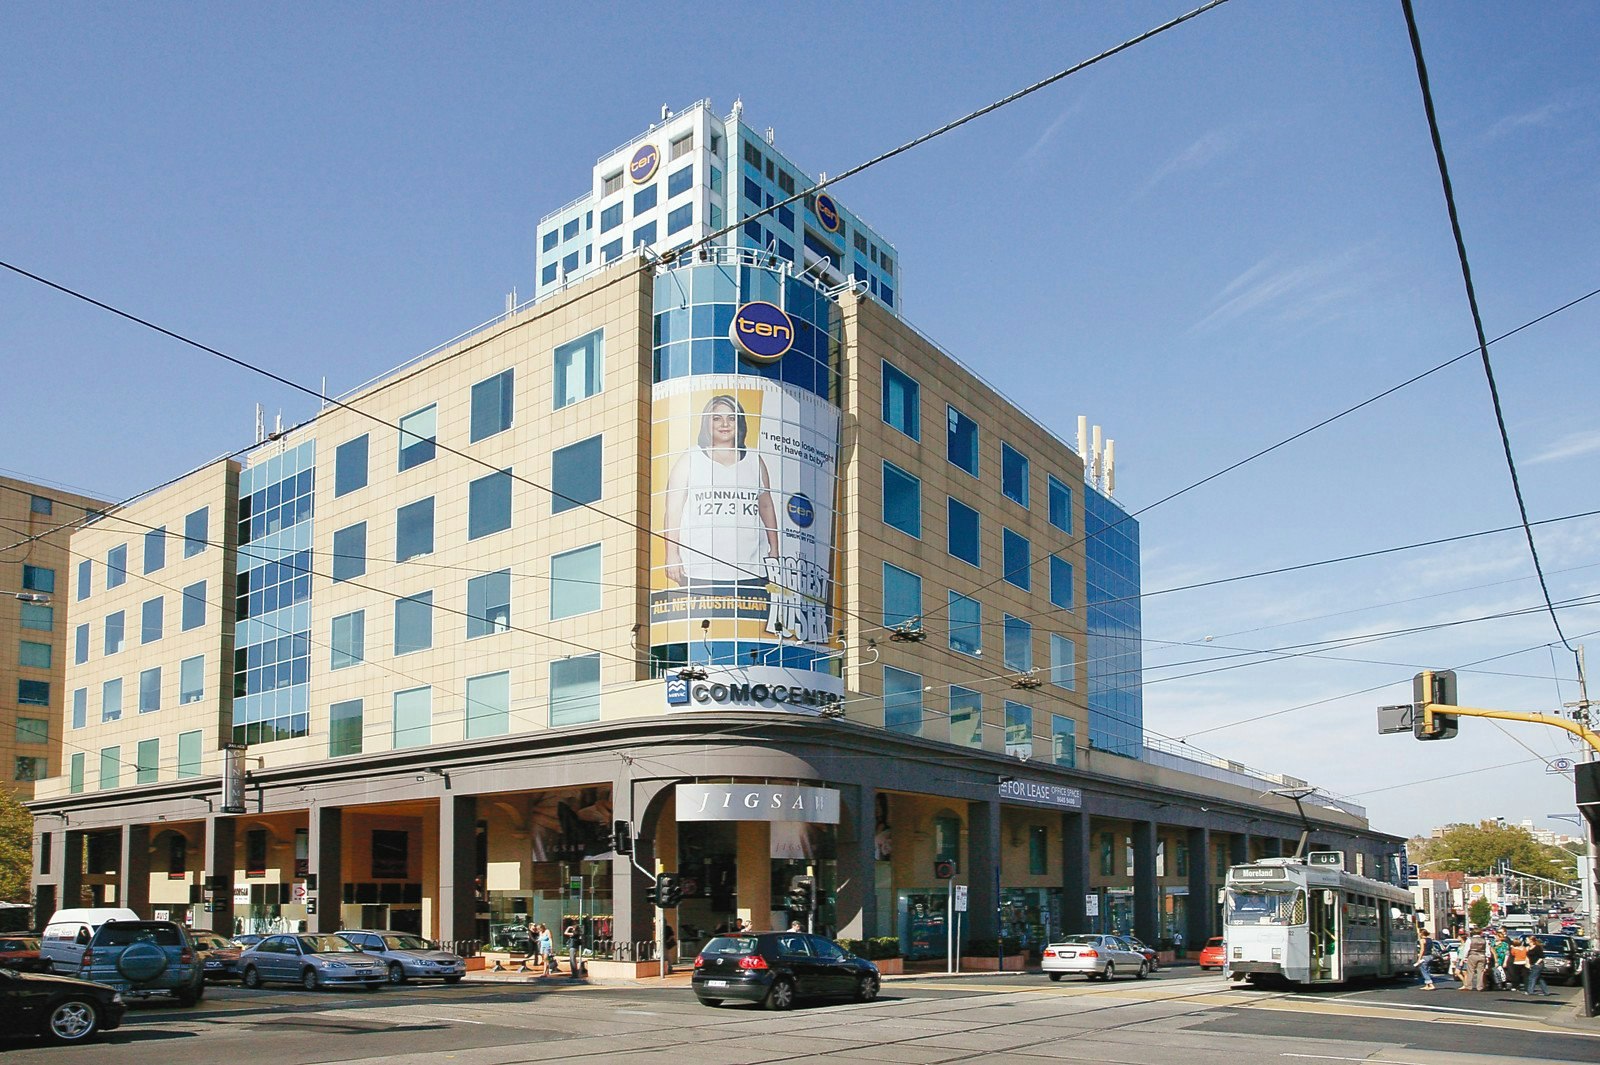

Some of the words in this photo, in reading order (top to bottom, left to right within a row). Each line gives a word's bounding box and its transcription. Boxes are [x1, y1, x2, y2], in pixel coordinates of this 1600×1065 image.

[631, 152, 656, 172] ten
[818, 200, 837, 225] ten
[738, 317, 790, 340] ten
[770, 434, 791, 444] need
[792, 438, 800, 447] to
[801, 441, 815, 453] lose
[815, 449, 834, 464] weight
[774, 443, 783, 451] to
[784, 445, 803, 457] have
[697, 502, 736, 516] 127.3
[743, 503, 759, 516] KG
[788, 503, 814, 519] ten
[763, 556, 830, 604] BIGGEST
[653, 600, 671, 614] ALL
[672, 596, 697, 611] NEW
[698, 595, 767, 611] AUSTRALIAN
[233, 750, 241, 806] CINEMA
[1008, 781, 1025, 796] FOR
[1027, 783, 1050, 799] LEASE
[1051, 786, 1066, 796] OFFICE
[1067, 788, 1080, 797] SPACE
[698, 792, 824, 812] JIGSAW
[1243, 869, 1273, 877] Moreland
[1409, 865, 1416, 874] P
